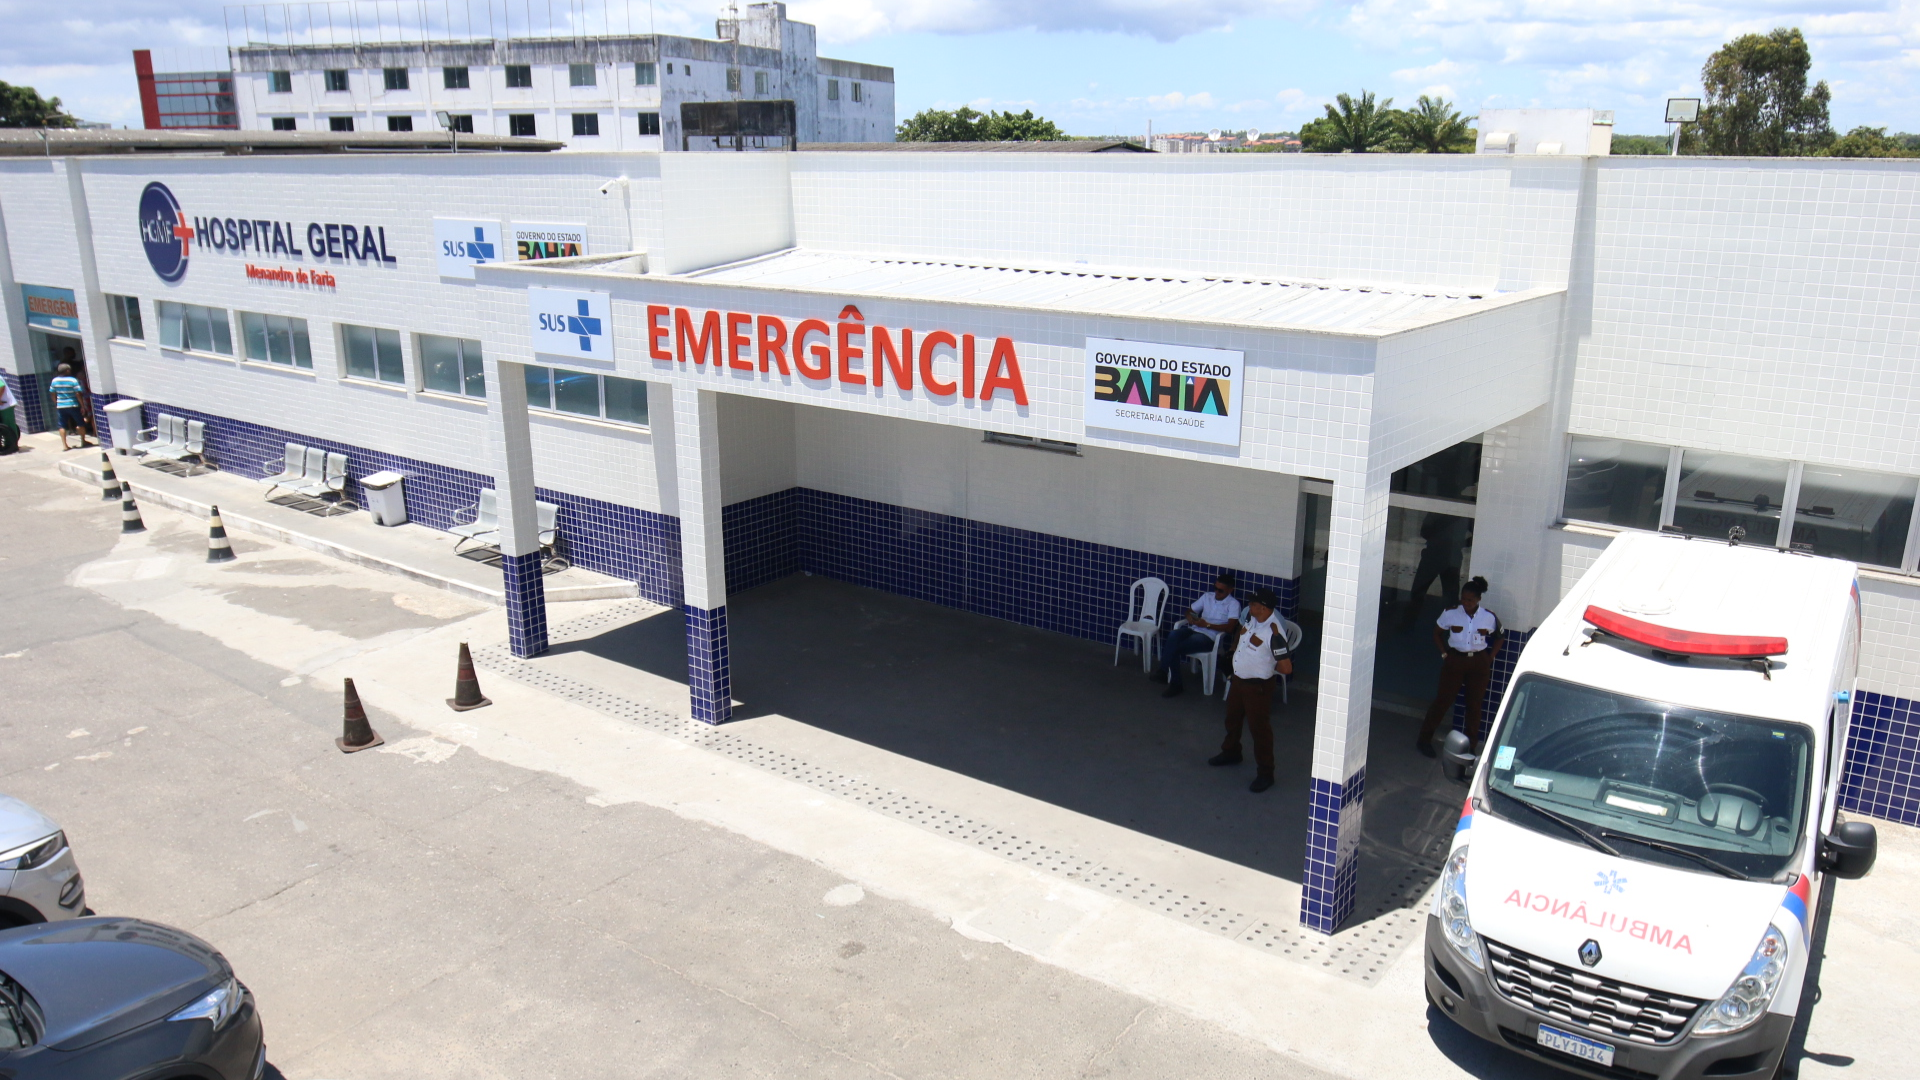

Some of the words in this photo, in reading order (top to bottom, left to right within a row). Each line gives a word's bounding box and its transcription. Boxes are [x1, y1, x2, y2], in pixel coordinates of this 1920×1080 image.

[194, 216, 302, 256] HOSPITAL
[307, 222, 396, 262] GERAL
[443, 240, 465, 257] SUS
[516, 231, 545, 240] GOVERNO
[557, 233, 581, 242] ESTADO
[245, 264, 294, 283] Menandro
[296, 268, 309, 284] de
[310, 269, 336, 287] Faria
[539, 312, 565, 332] SUS
[647, 304, 1029, 406] EMERGÊNCIA
[1095, 352, 1156, 369] GOVERNO
[1159, 359, 1178, 371] DO
[1181, 361, 1232, 377] ESTADO
[1095, 365, 1229, 417] BAHIA
[1115, 408, 1163, 423] SECRETARIA
[1165, 415, 1176, 425] DA
[1178, 417, 1205, 429] SAÚDE
[1545, 1033, 1605, 1062] PLY1D14
